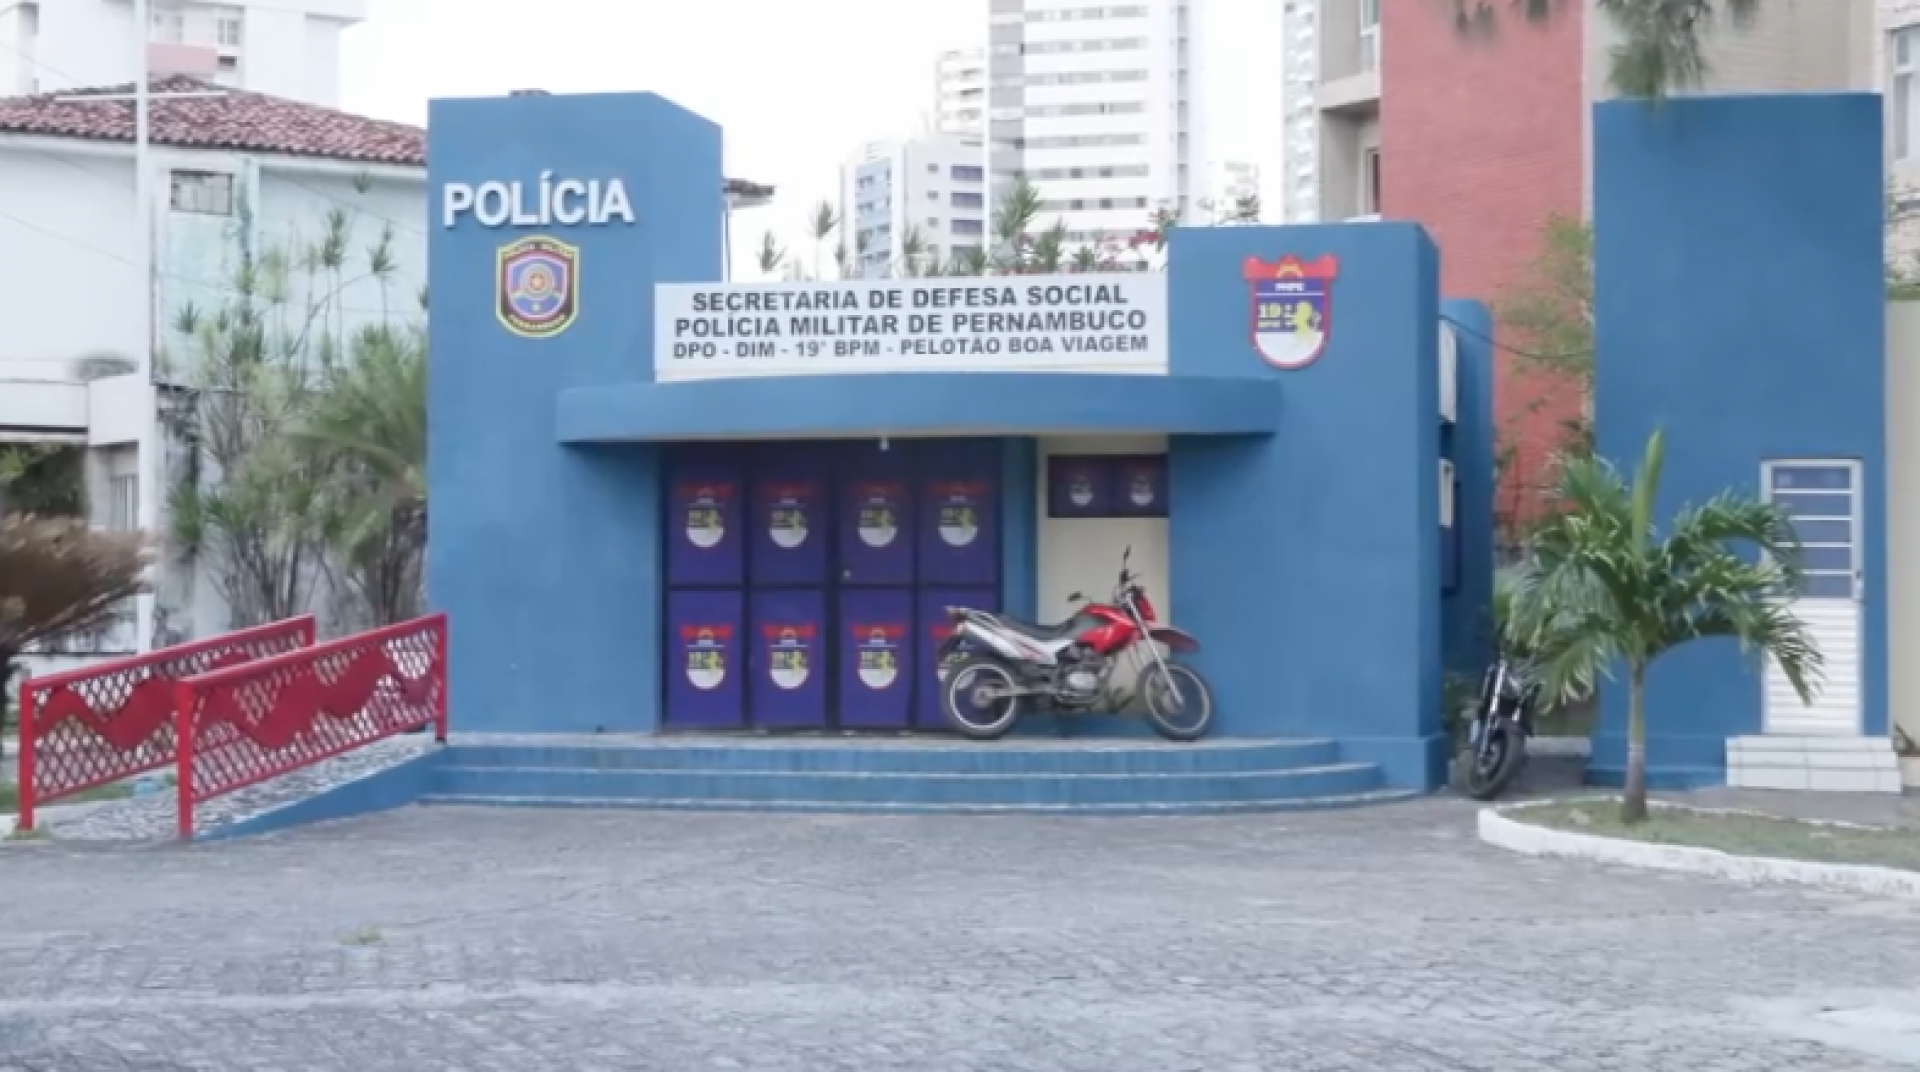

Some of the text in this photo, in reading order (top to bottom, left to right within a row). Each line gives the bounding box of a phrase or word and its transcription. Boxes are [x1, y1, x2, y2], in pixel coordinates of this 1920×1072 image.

[443, 168, 635, 227] POLÍCIA
[692, 285, 1129, 312] SECRETARIA DE DEFESA SOCIAL
[675, 311, 1147, 337] POLÍCIA MILITAR DE PERNAMBUCO
[673, 341, 717, 359] DPO
[736, 341, 776, 358] DIM
[834, 340, 880, 357] BPM
[900, 334, 1001, 355] PELOTÃO
[1008, 336, 1054, 353] BOA
[1061, 334, 1149, 353] VIAGEM
